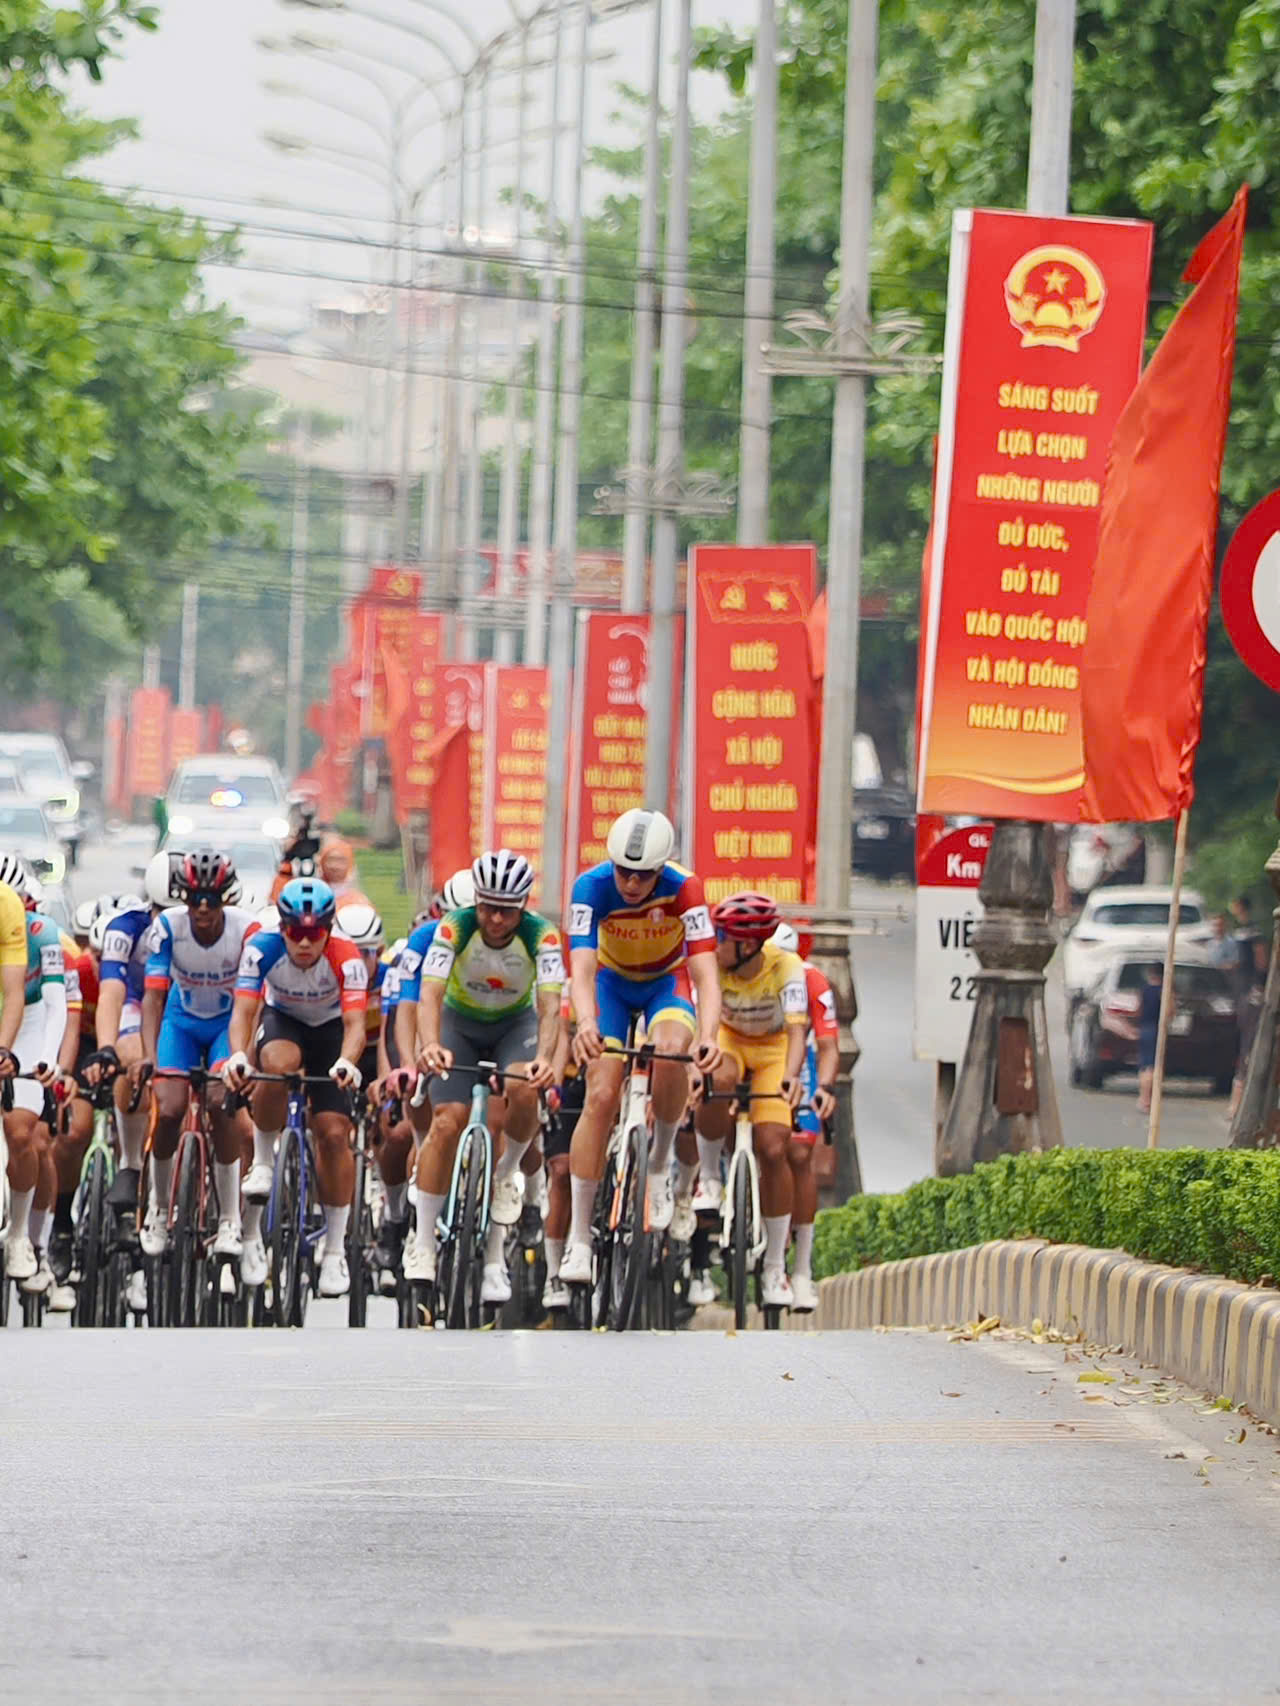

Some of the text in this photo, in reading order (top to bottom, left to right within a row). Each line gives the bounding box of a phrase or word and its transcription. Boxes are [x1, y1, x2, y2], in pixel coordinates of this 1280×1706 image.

[998, 380, 1100, 415] SÁNG SUỐT
[997, 429, 1088, 463] LỰA CHỌN
[1030, 566, 1061, 596] TÀI
[966, 607, 1002, 638] VÀO
[1004, 609, 1054, 641] QUỐC
[966, 652, 991, 682] VÀ
[993, 656, 1026, 688] HỘI
[968, 703, 1019, 730] NHÂN
[946, 852, 982, 879] Km
